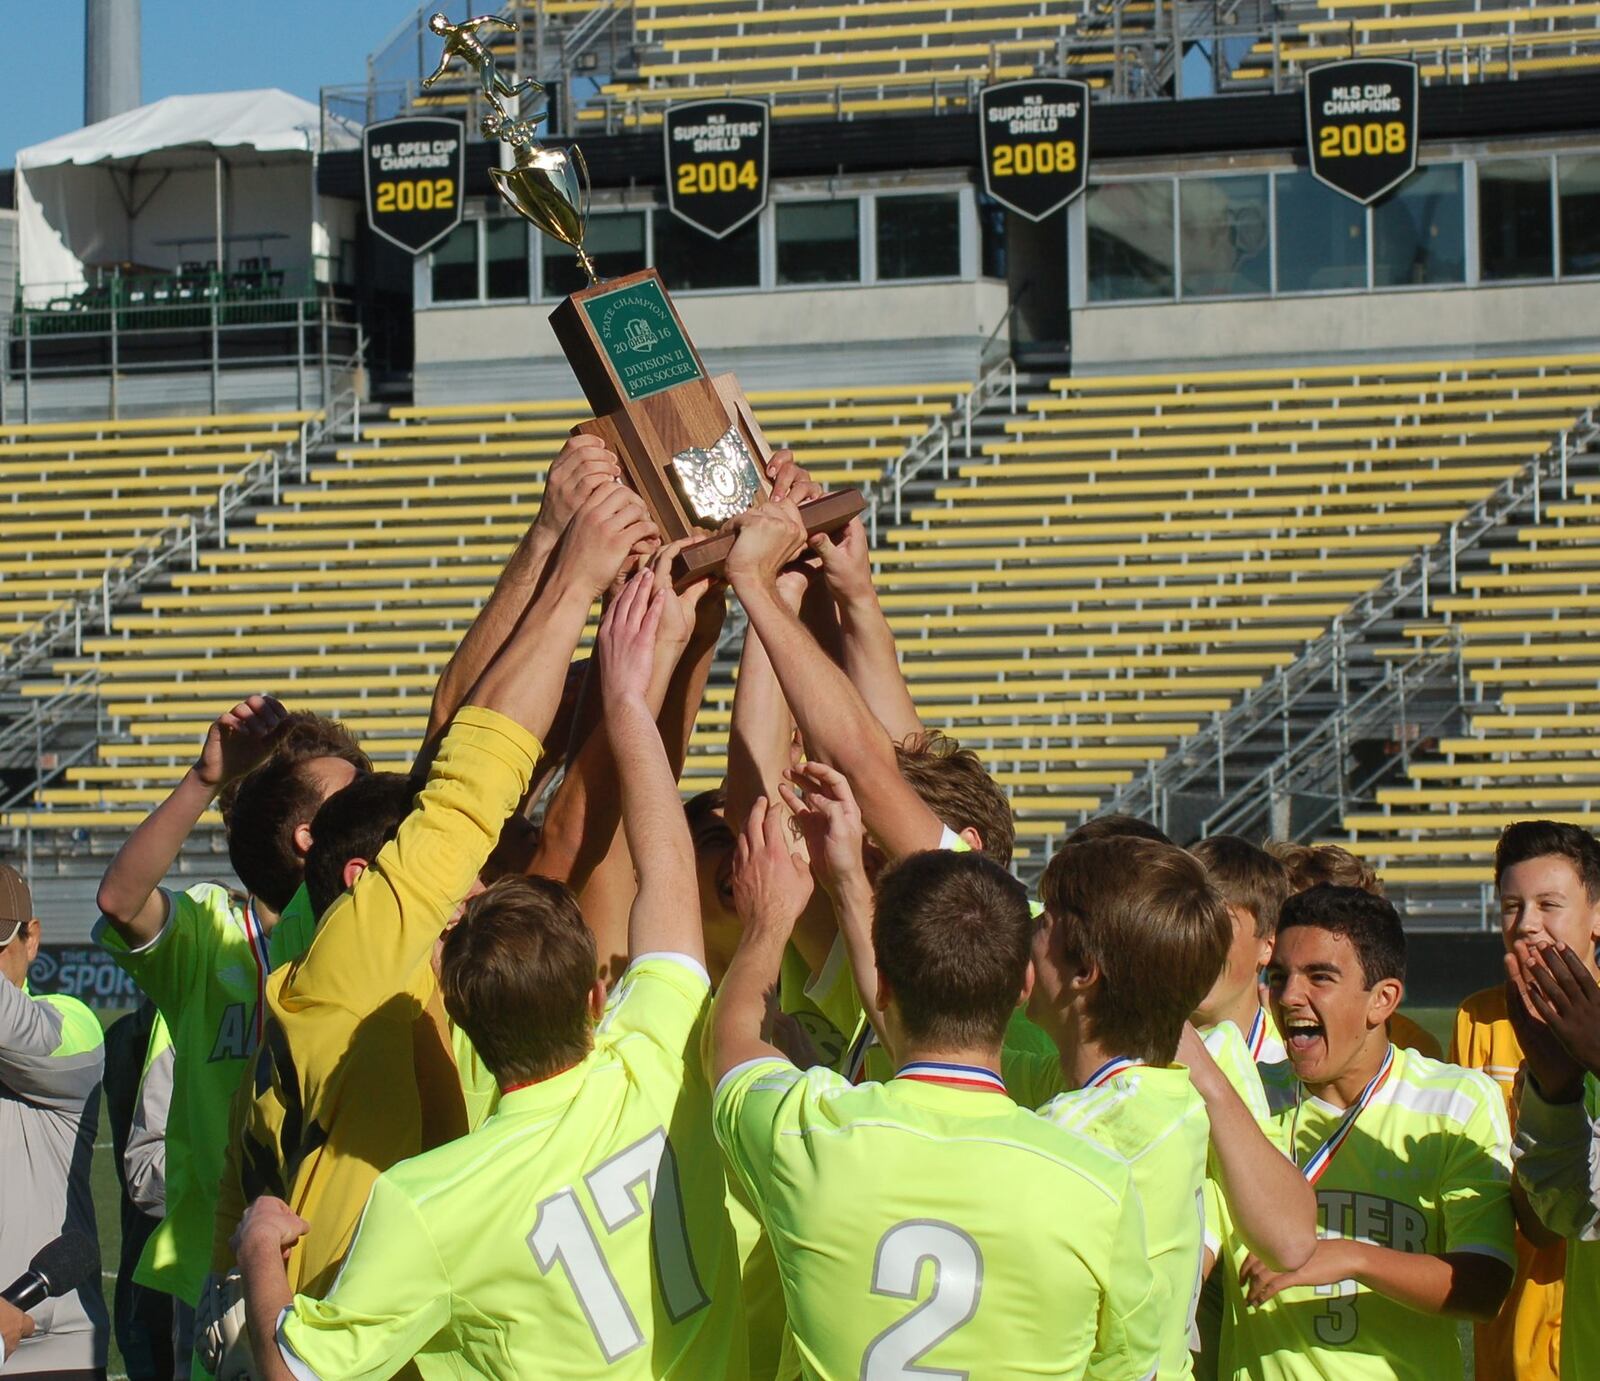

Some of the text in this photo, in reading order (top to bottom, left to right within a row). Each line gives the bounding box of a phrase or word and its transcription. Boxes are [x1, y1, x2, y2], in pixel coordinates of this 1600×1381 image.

[1023, 94, 1043, 105] MLS
[1332, 84, 1392, 100] MLS CUP
[988, 102, 1080, 122] SUPPORTERS'
[1323, 97, 1401, 116] CHAMPIONS
[673, 121, 761, 141] SUPPORTERS'
[1009, 118, 1058, 135] SHIELD
[1320, 121, 1406, 158] 2008
[371, 139, 458, 158] U.S. OPEN CUP
[693, 137, 741, 153] SHIELD
[993, 140, 1077, 176] 2008
[380, 153, 450, 171] CHAMPIONS
[677, 159, 759, 194] 2004
[377, 178, 454, 212] 2002
[602, 297, 667, 338] STATE CHAMPION
[613, 327, 672, 354] 20 16
[624, 349, 685, 377] DIVISION II
[628, 362, 693, 391] BOYS SOCCER
[526, 1124, 711, 1364] 17
[860, 1217, 985, 1381] 2
[1312, 1279, 1359, 1345] 3
